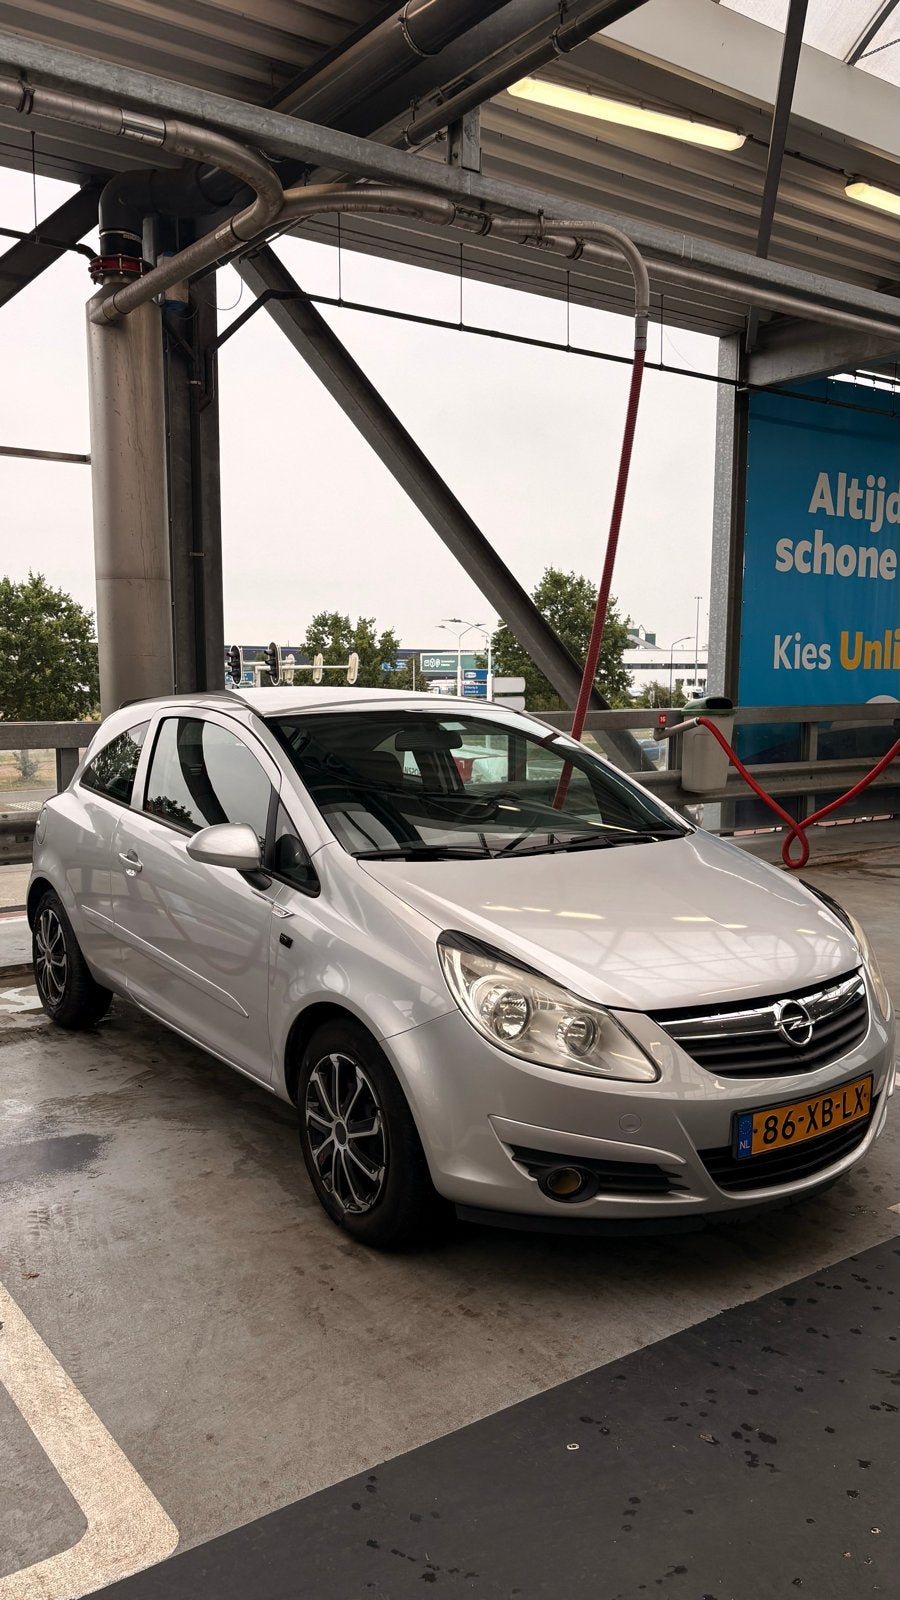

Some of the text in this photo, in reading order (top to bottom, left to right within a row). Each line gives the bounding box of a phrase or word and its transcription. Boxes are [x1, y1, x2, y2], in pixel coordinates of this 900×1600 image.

[808, 472, 900, 533] Altijd
[775, 529, 897, 580] schone
[773, 632, 831, 671] Kies
[763, 1084, 865, 1145] 86-XB-LX
[739, 1139, 751, 1151] NL
